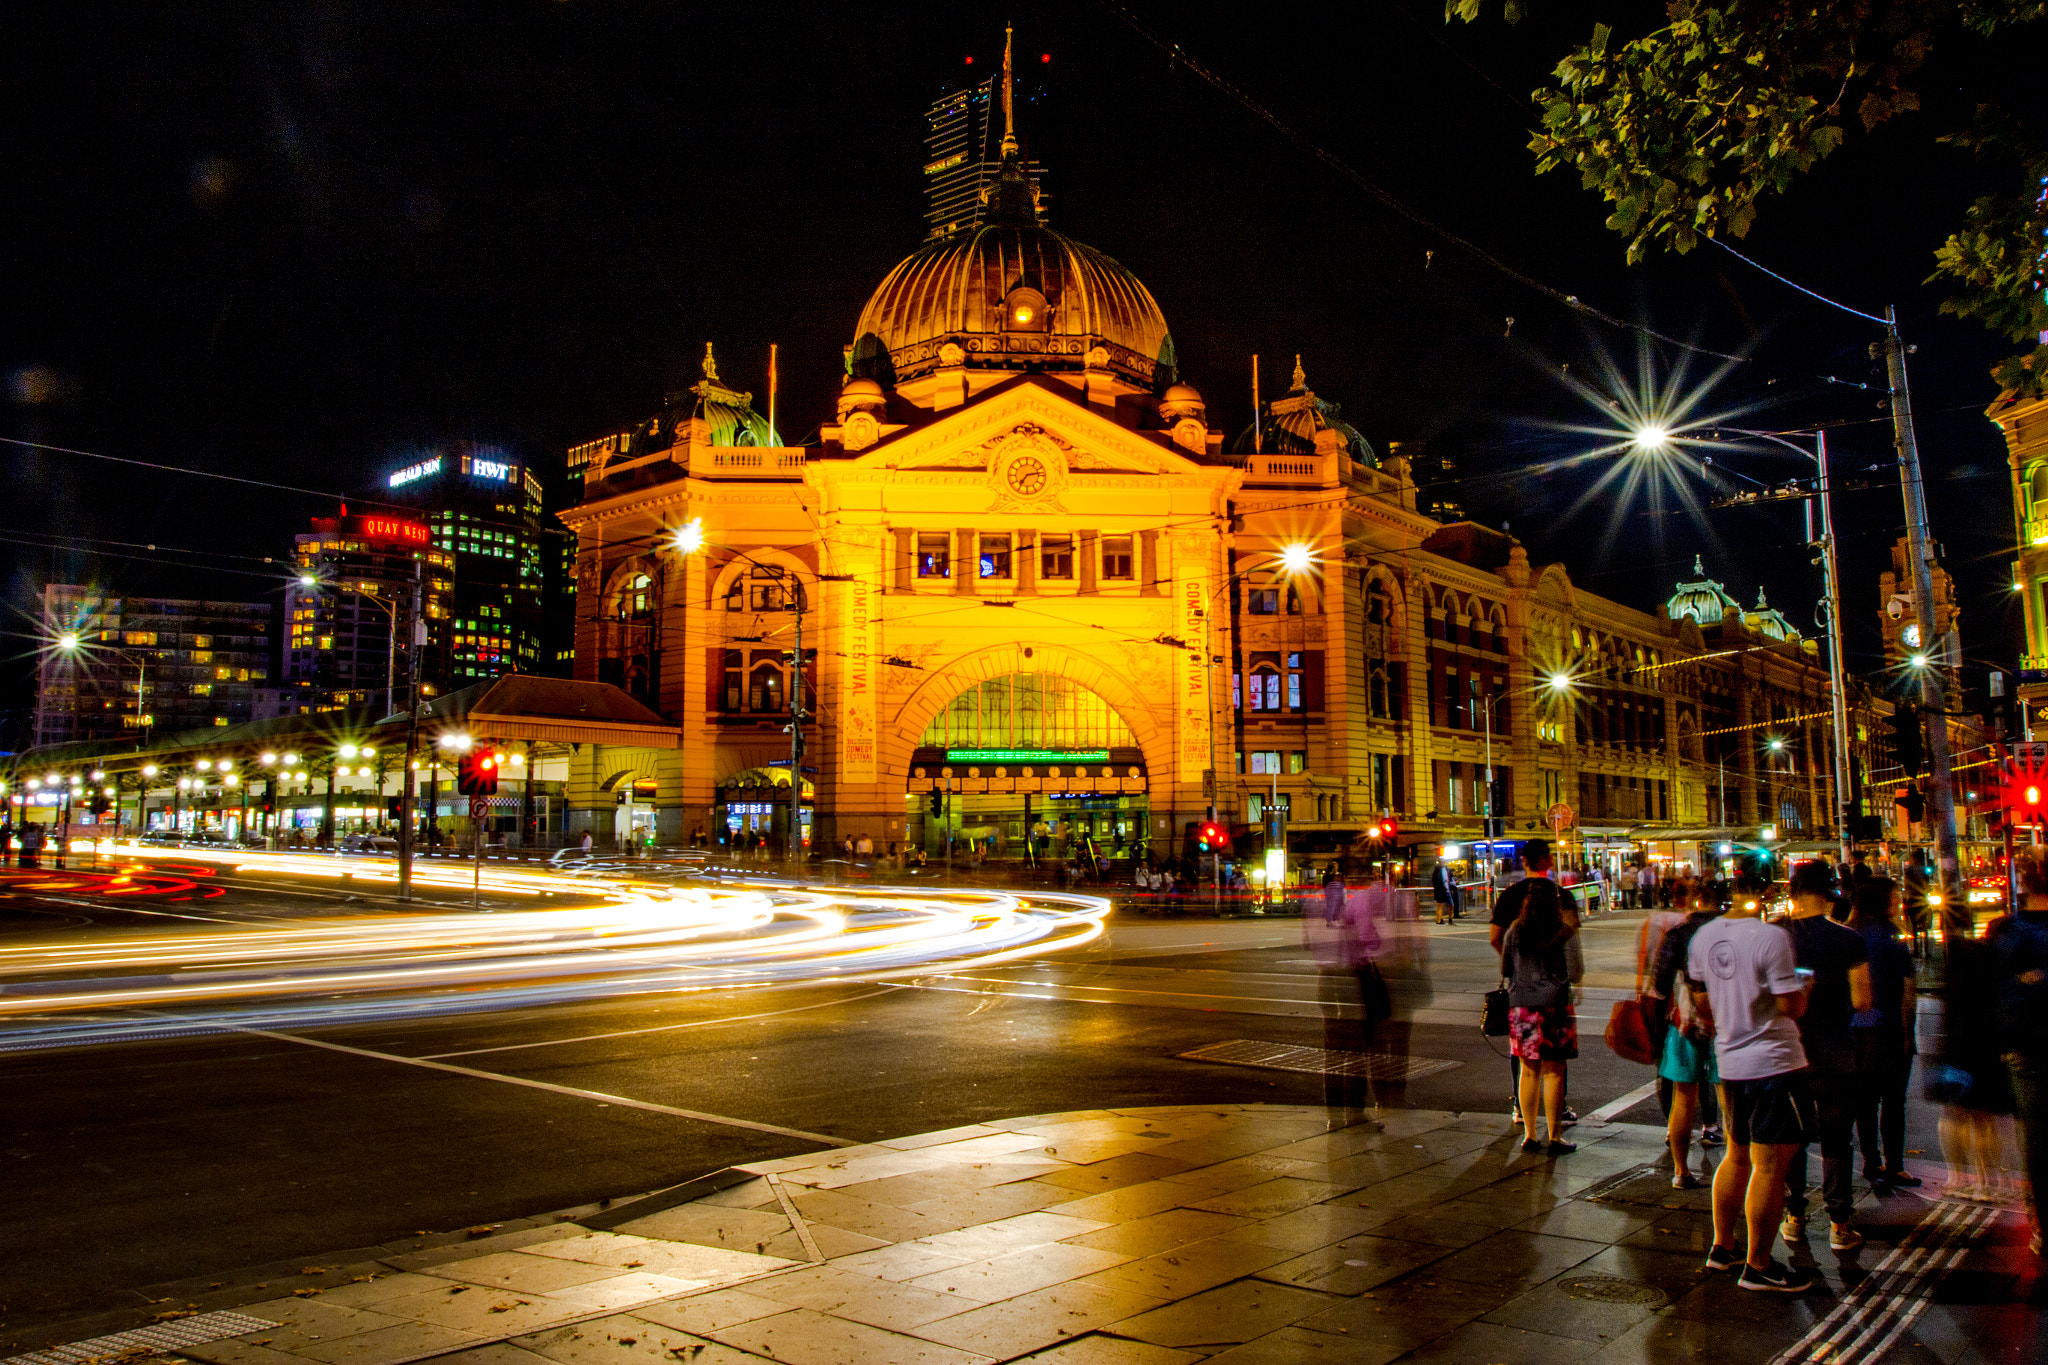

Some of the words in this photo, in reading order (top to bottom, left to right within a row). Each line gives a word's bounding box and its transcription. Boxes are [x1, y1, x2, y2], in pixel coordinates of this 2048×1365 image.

[423, 459, 441, 475] SUN
[474, 458, 508, 480] HWT
[367, 520, 399, 535] QUAY
[404, 525, 427, 541] WEST
[853, 580, 867, 631] COMEDY
[852, 636, 867, 697] FESTIVAL
[1187, 638, 1203, 698] FETIVAL
[846, 745, 873, 753] COMEDY
[1183, 745, 1209, 753] COMEDY
